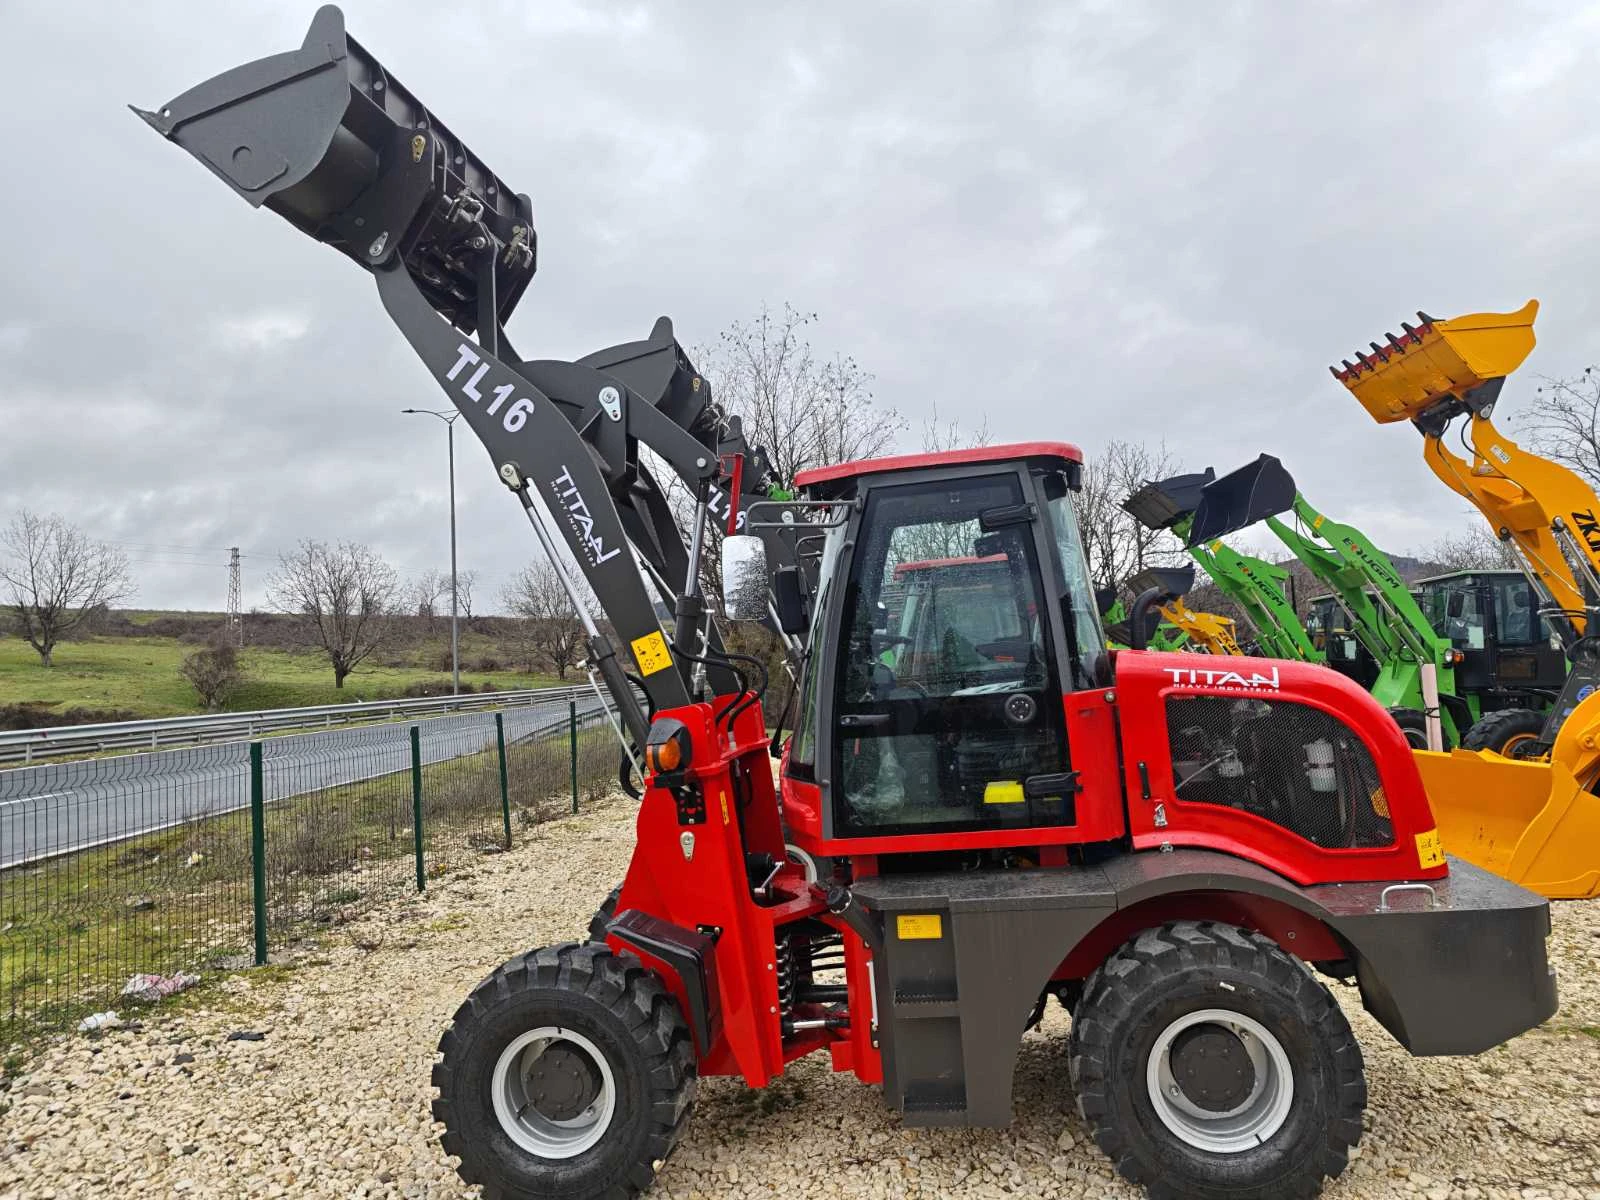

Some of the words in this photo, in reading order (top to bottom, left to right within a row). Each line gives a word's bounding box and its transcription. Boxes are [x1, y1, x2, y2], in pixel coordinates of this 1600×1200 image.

[446, 343, 535, 433] TL16
[550, 481, 569, 510] HEAVY
[567, 513, 597, 568] INDUSTRIES
[555, 464, 621, 564] TITAN
[1163, 666, 1280, 689] TITAN
[1214, 685, 1280, 694] INDUSTRIES
